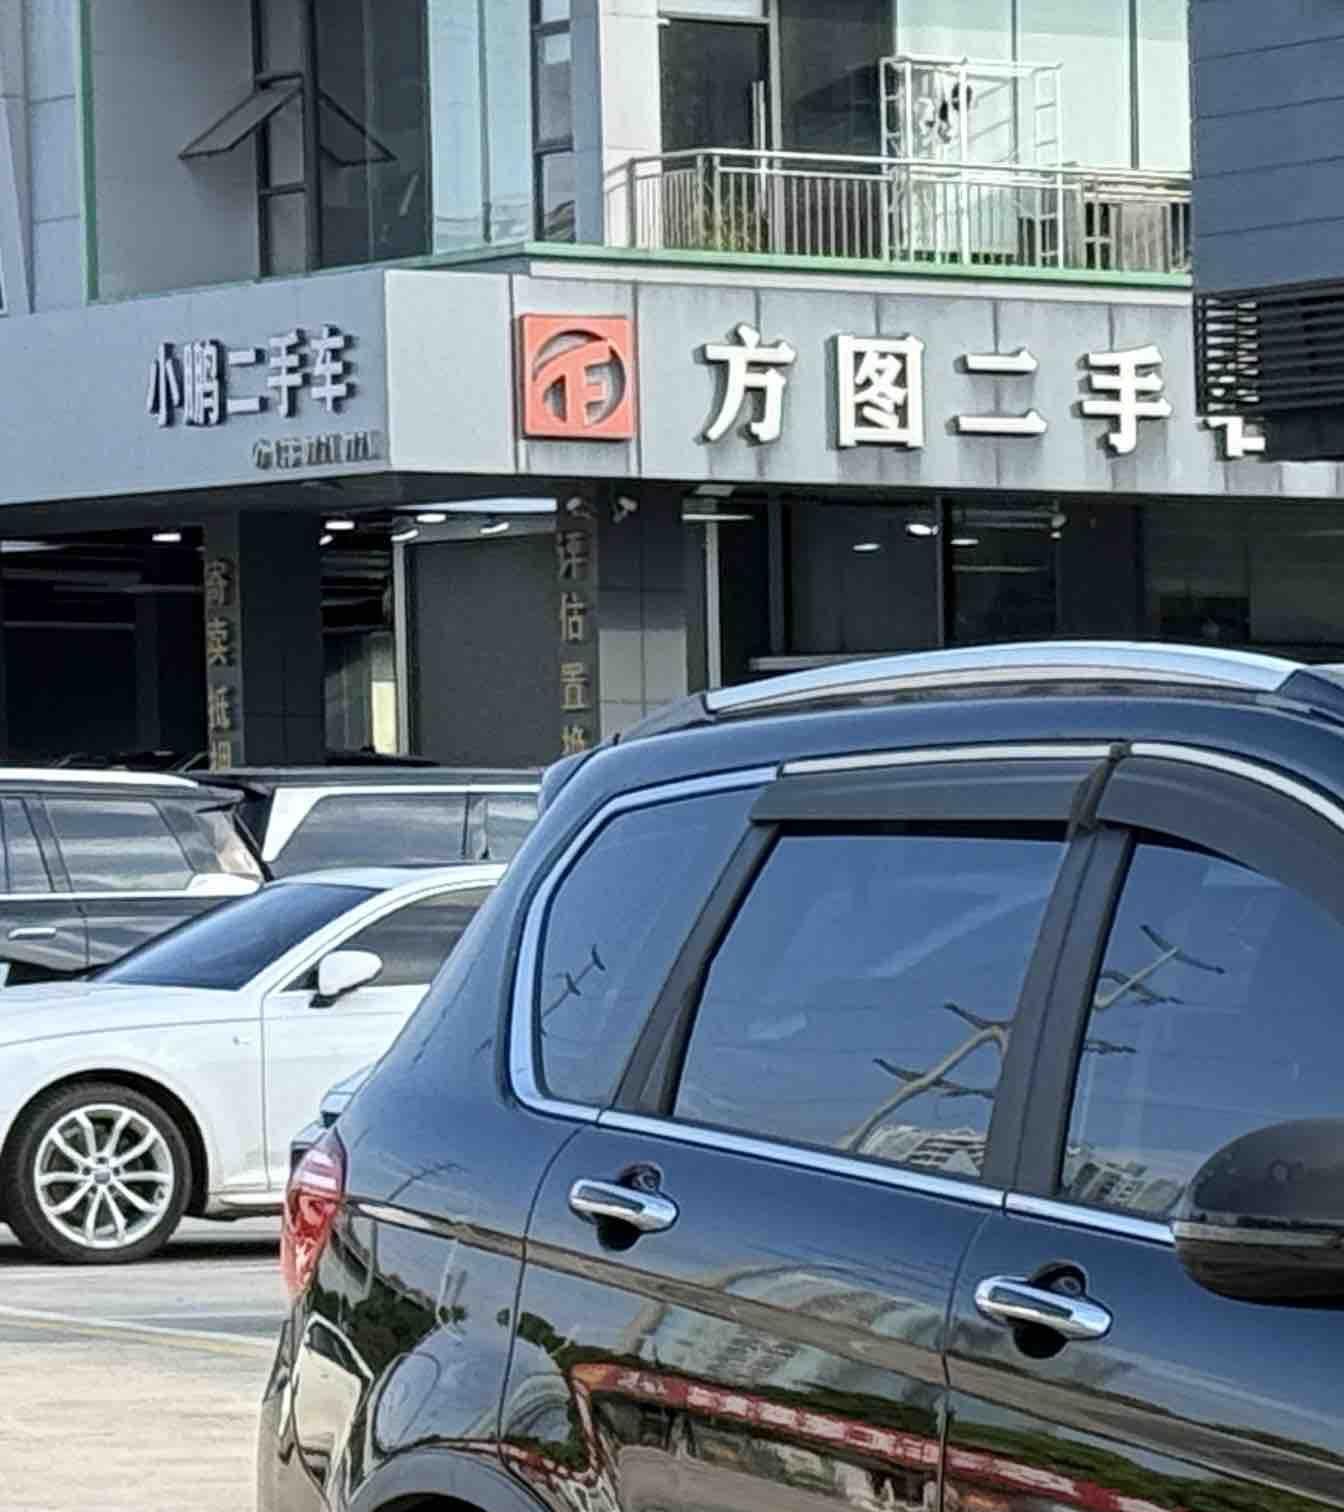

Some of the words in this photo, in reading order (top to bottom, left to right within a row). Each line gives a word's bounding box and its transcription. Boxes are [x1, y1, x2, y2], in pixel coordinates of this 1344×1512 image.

[147, 325, 352, 426] 小鹏二手车
